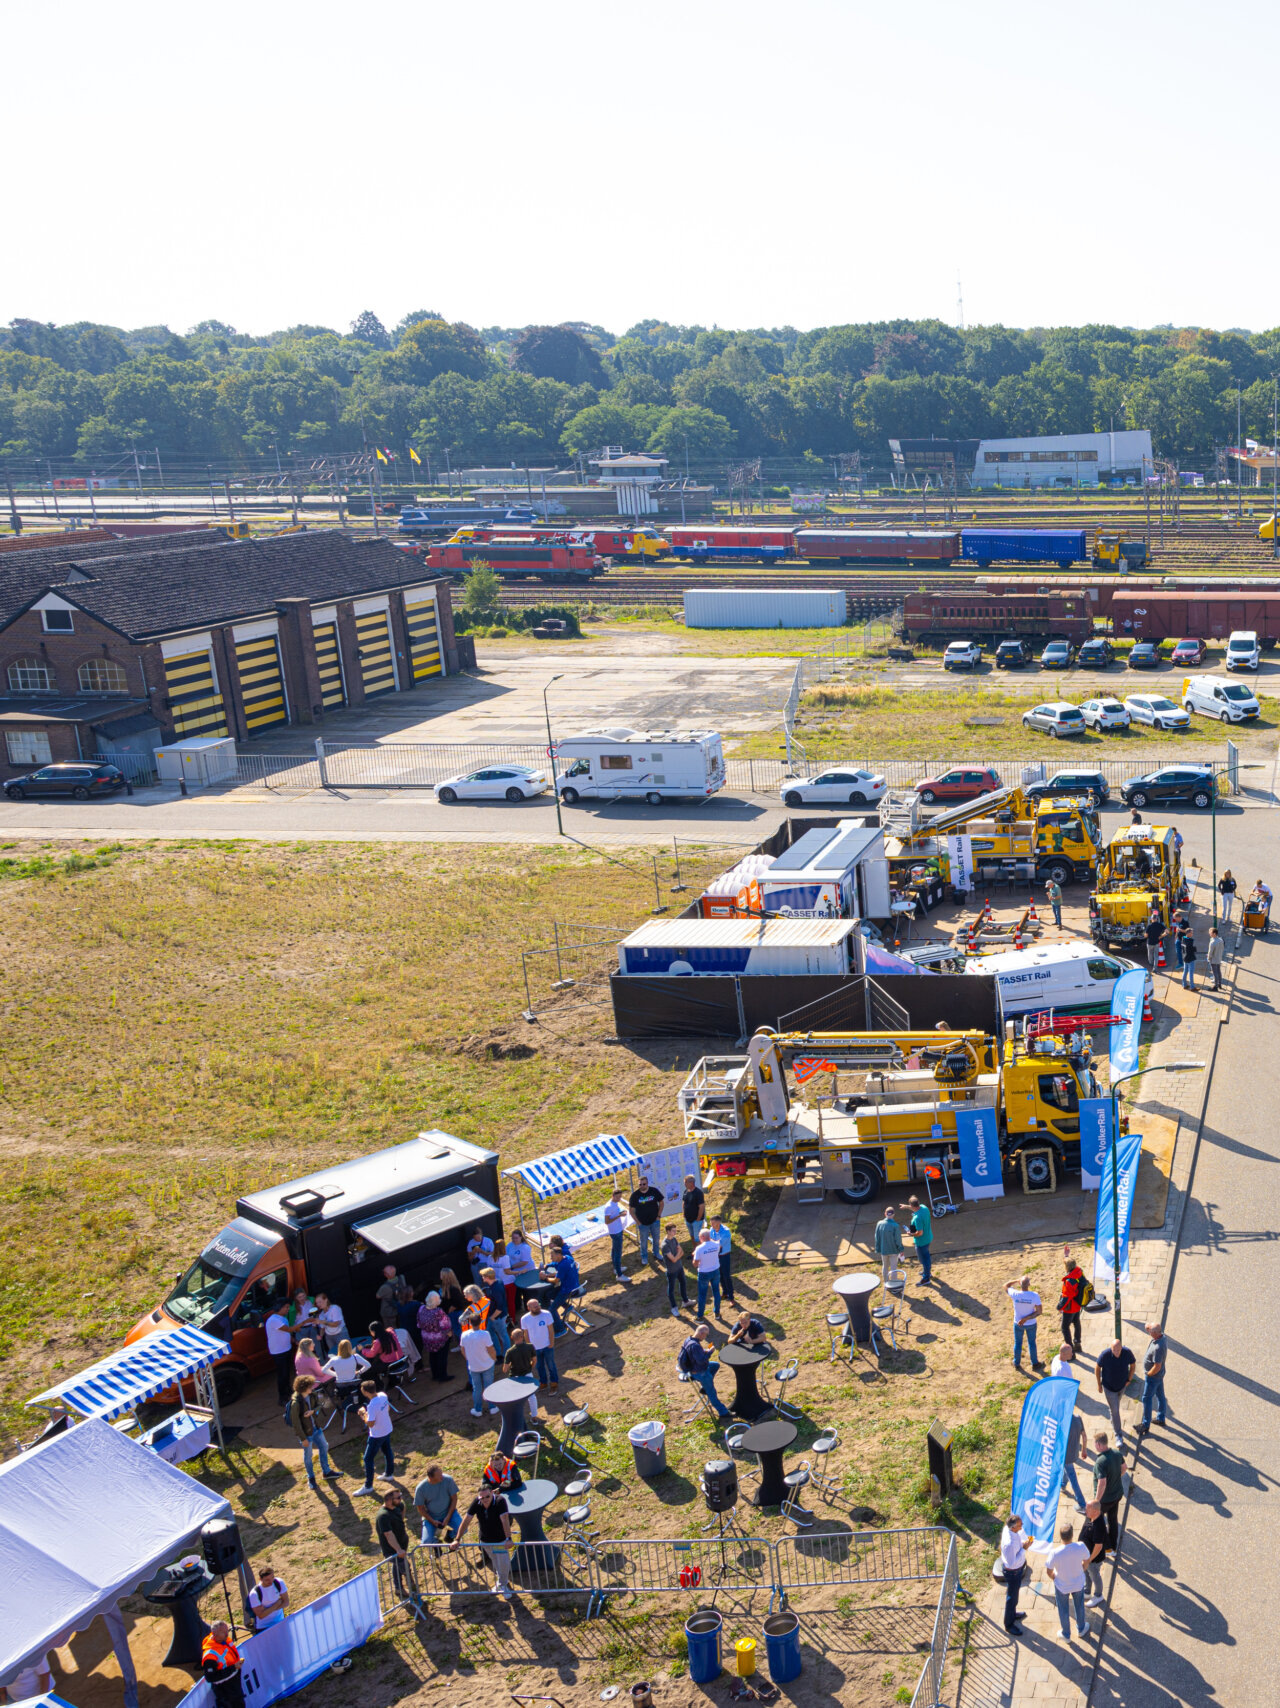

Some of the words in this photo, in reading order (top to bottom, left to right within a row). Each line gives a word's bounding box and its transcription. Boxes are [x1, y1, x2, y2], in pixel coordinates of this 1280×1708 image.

[1004, 973, 1033, 984] ASSET
[1035, 970, 1051, 979] Rail
[975, 1119, 988, 1162] VolkerRail
[1096, 1108, 1107, 1150] VolkerRail
[1116, 1168, 1130, 1234] VolkerRail
[1034, 1416, 1058, 1498] VolkerRail
